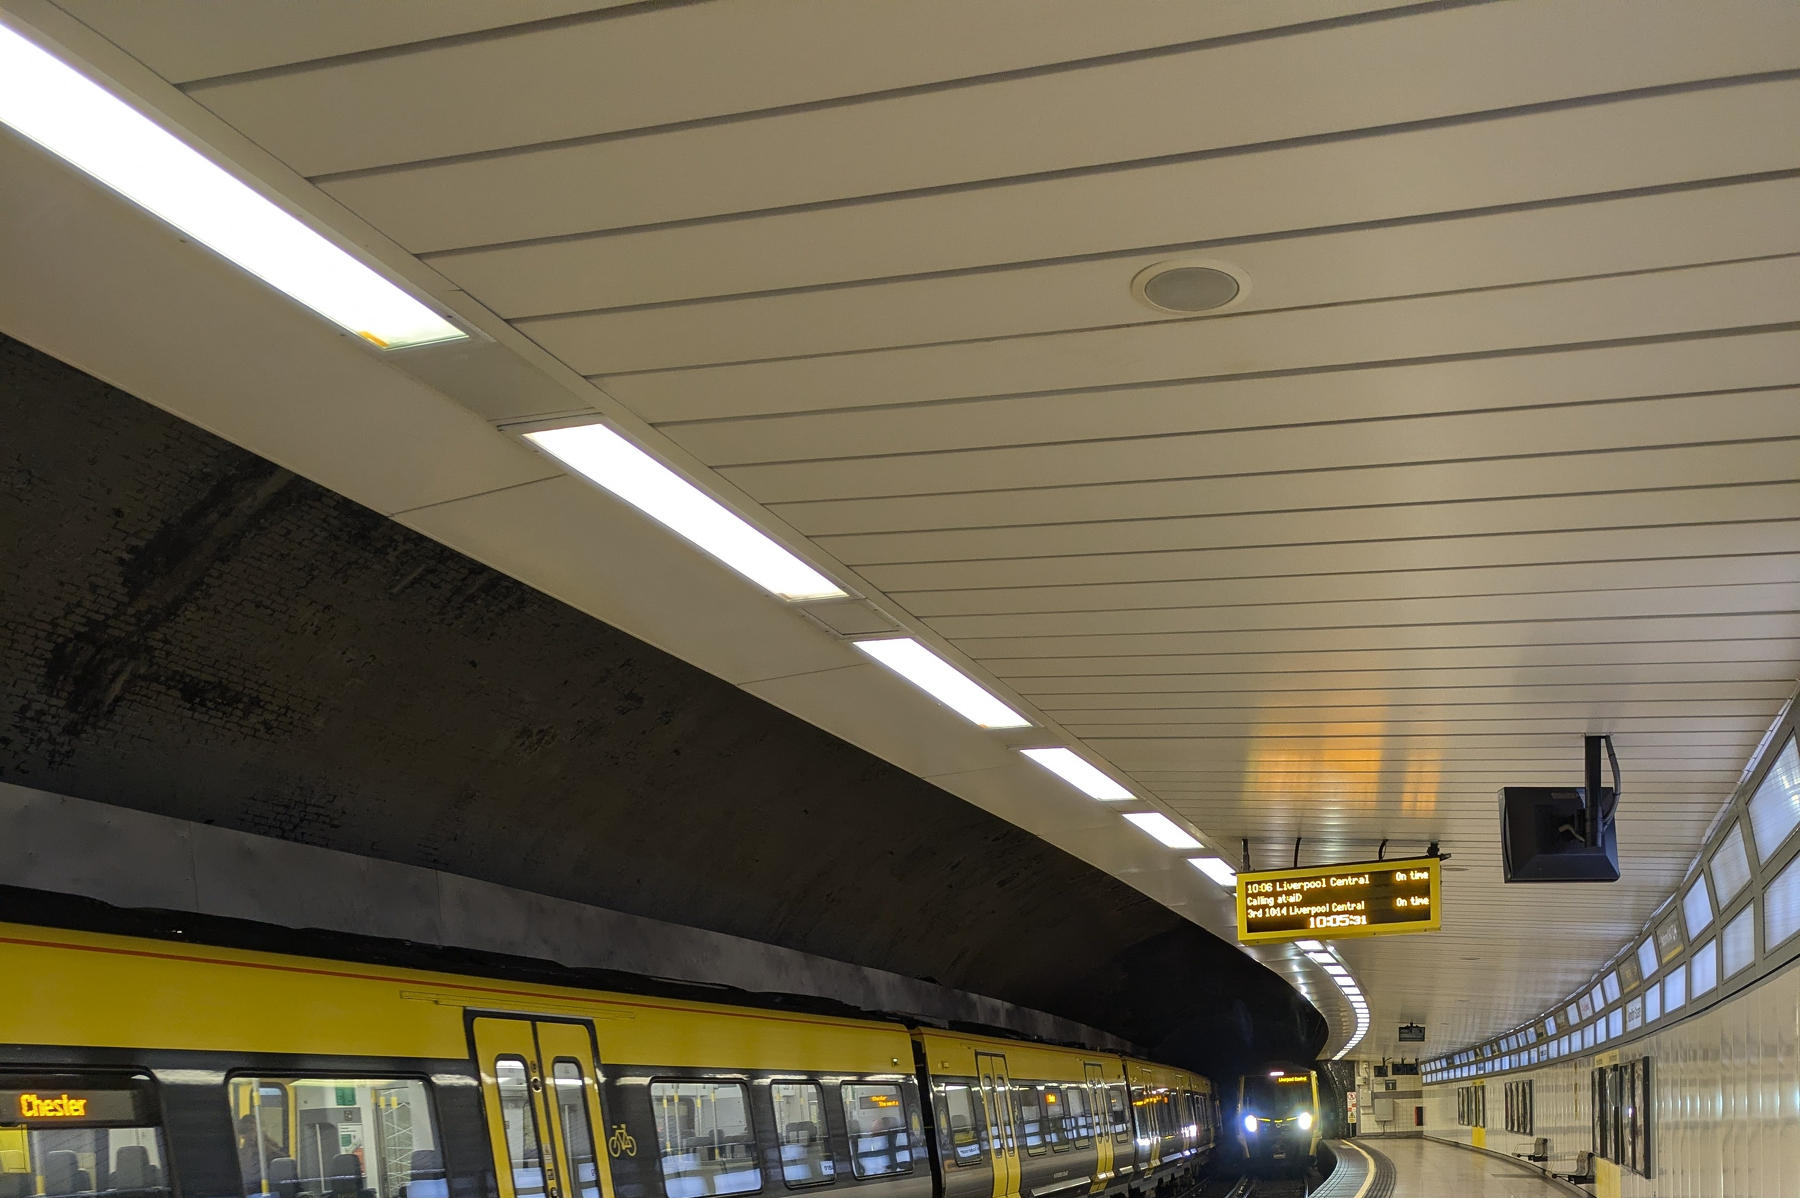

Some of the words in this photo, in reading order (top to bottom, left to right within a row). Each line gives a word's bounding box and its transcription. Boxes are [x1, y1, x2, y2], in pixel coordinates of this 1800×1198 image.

[1395, 871, 1407, 882] On
[1410, 870, 1429, 880] time
[1247, 882, 1273, 894] 10:06
[1276, 878, 1326, 891] Liverpool
[1330, 875, 1370, 887] Central
[1247, 895, 1274, 907] Calling
[1396, 897, 1408, 907] On
[1410, 896, 1429, 906] time
[1248, 907, 1262, 918] 3rd
[1289, 903, 1329, 915] Liverpool
[1332, 900, 1365, 912] Central
[20, 1094, 87, 1117] Chester
